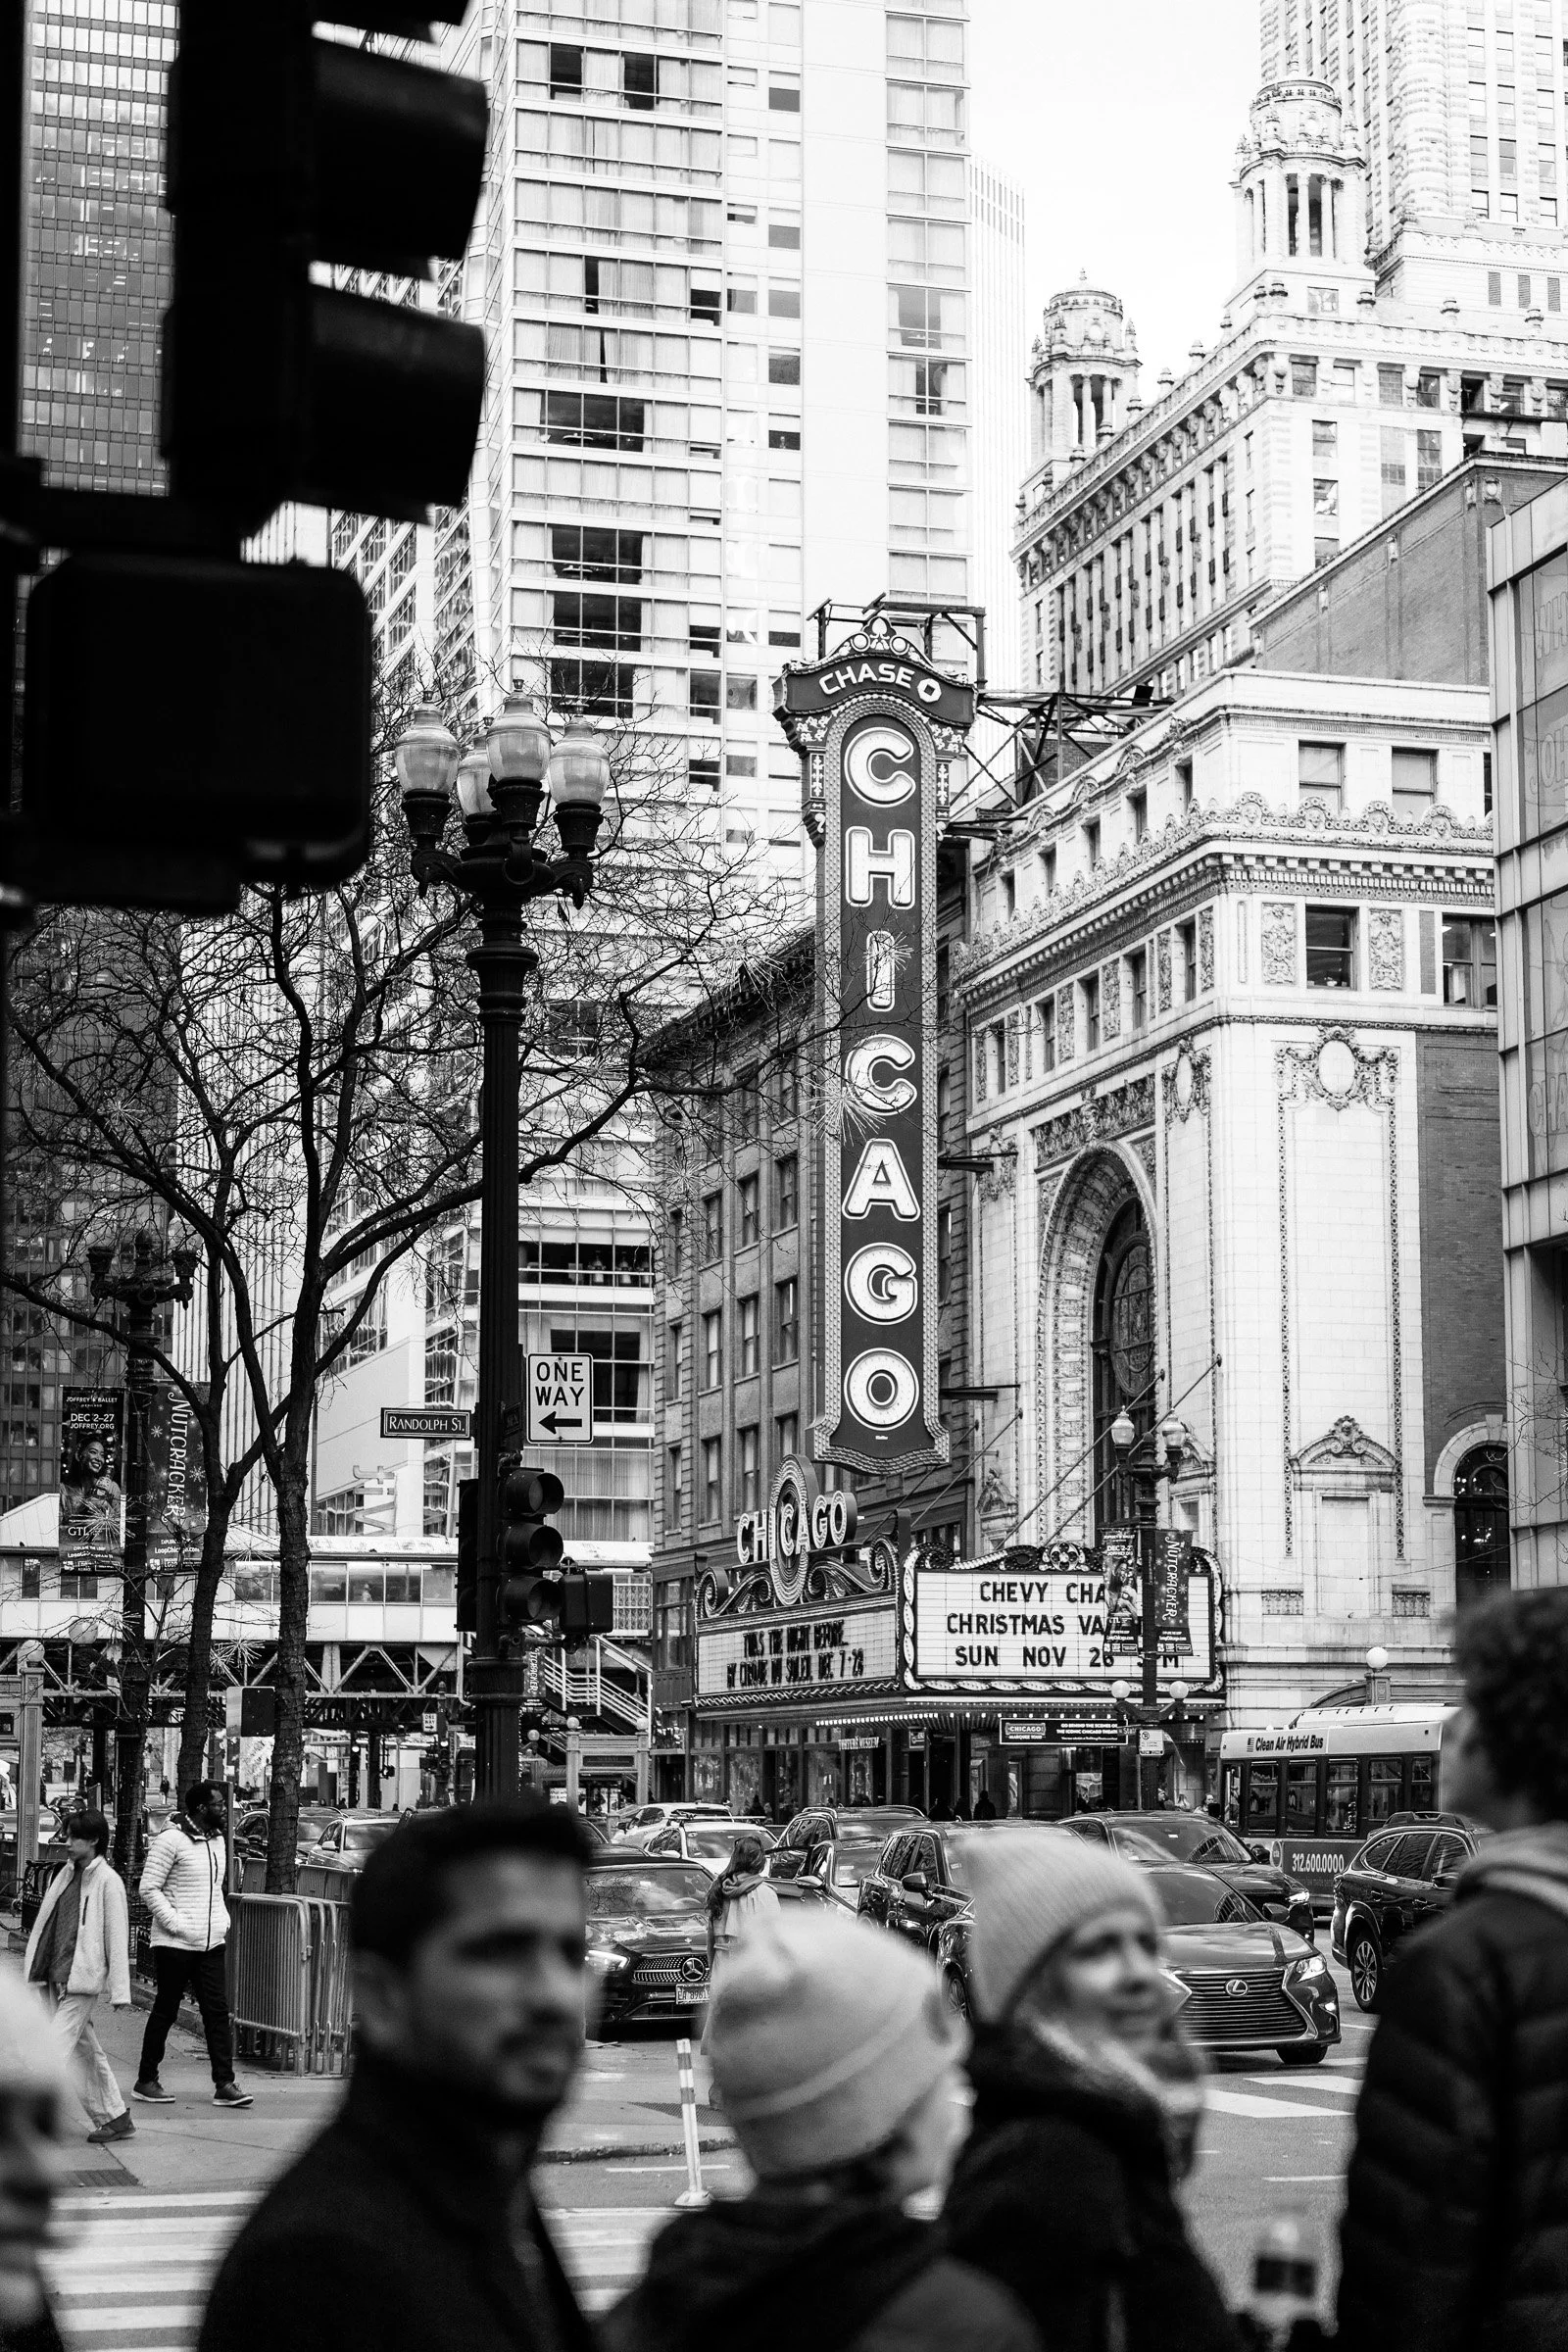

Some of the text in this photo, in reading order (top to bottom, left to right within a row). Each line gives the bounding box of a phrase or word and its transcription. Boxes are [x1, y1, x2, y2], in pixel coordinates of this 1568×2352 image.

[819, 662, 915, 697] CHASE
[842, 726, 921, 1432] CHICAGO
[536, 1361, 584, 1383] ONE
[535, 1386, 585, 1407] WAY
[71, 1413, 91, 1422] DEC
[389, 1415, 448, 1432] RANDOLPH
[162, 1392, 194, 1523] NUTCRACKER
[737, 1490, 848, 1564] CHICAGO
[1162, 1536, 1182, 1621] NUTCRACKER
[980, 1581, 1049, 1602] CHEVY
[947, 1613, 1065, 1636] CHRISTMAS
[955, 1644, 999, 1667] SUN
[1022, 1645, 1067, 1667] NOV
[1255, 1735, 1324, 1752] Clean Air Hybrid Bus
[1292, 1853, 1345, 1874] 312.600.0000
